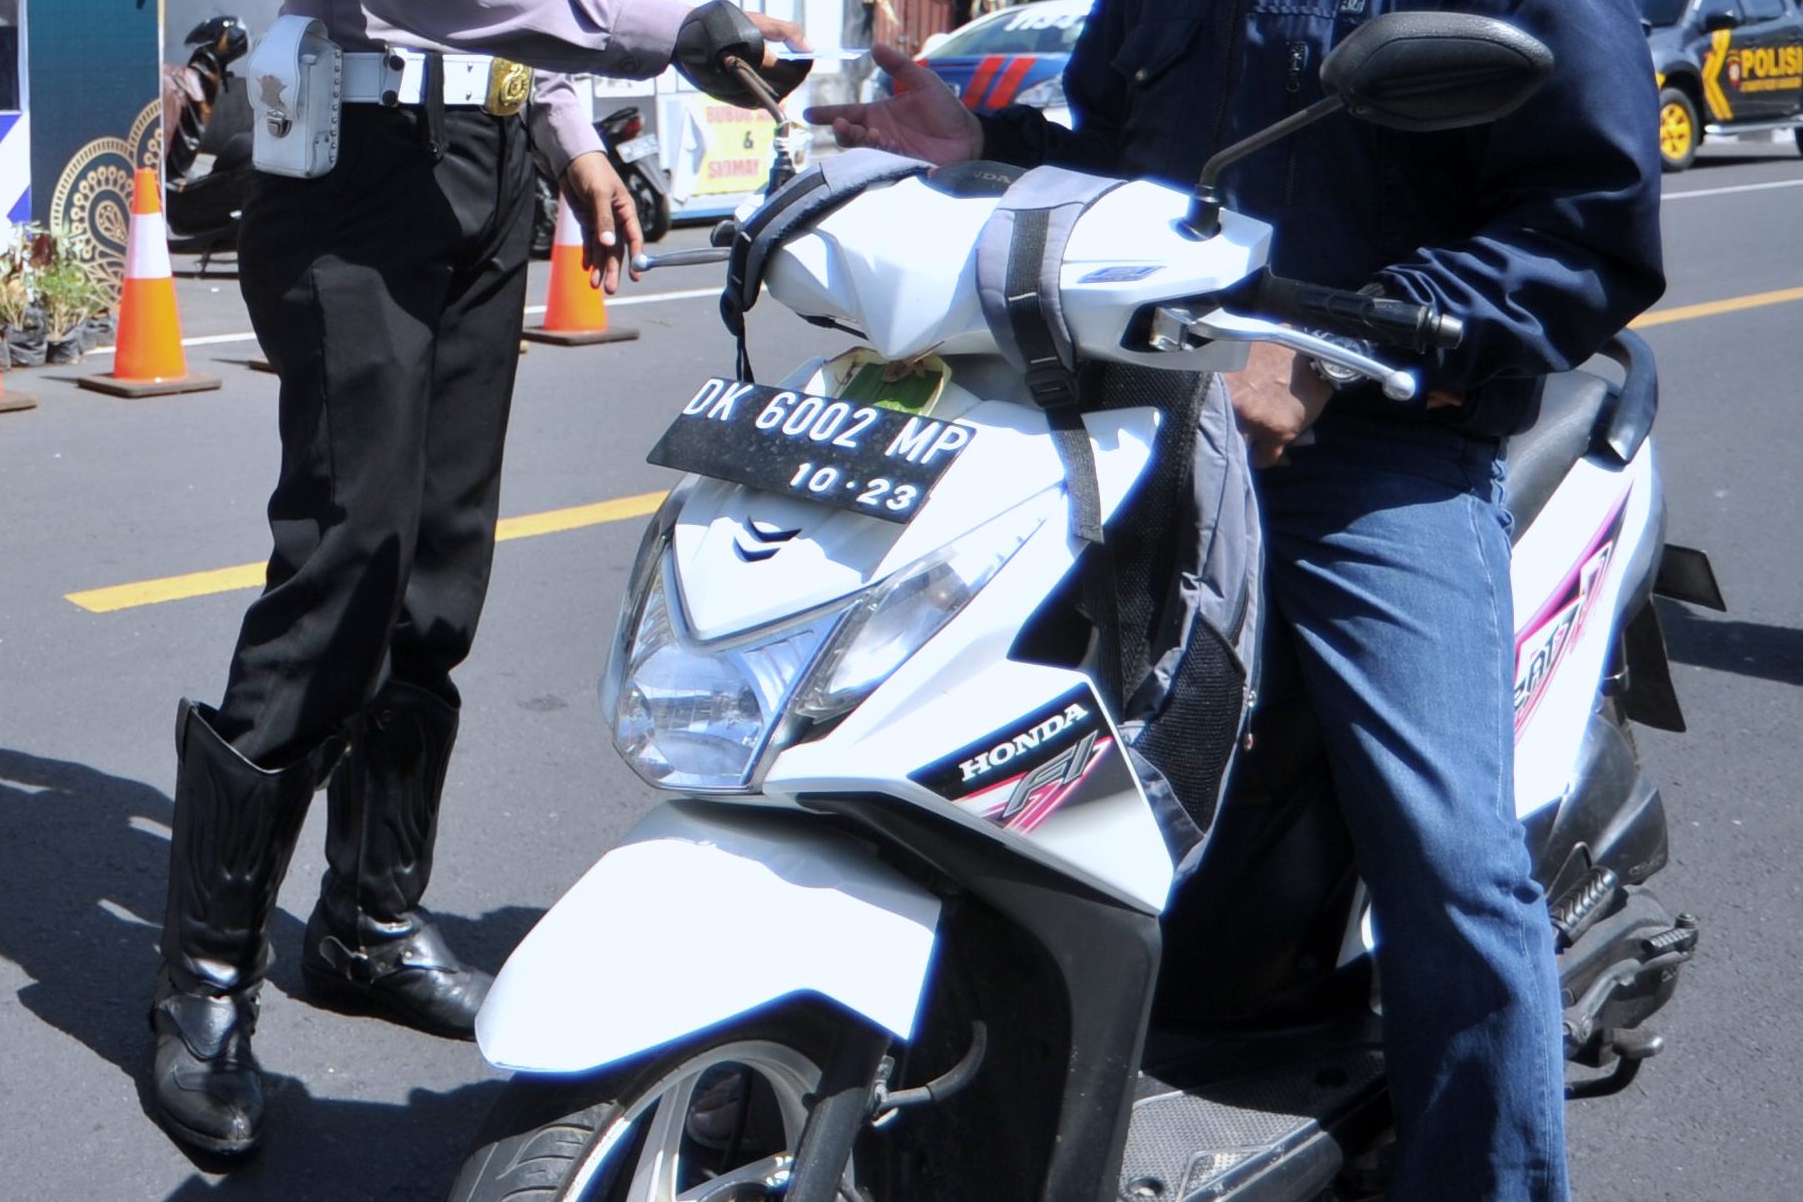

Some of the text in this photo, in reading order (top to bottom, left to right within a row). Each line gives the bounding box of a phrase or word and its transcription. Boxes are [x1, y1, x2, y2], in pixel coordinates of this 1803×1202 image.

[1740, 46, 1803, 79] POLISI
[682, 378, 970, 466] DK 6002 MP
[958, 703, 1089, 783] HONDA
